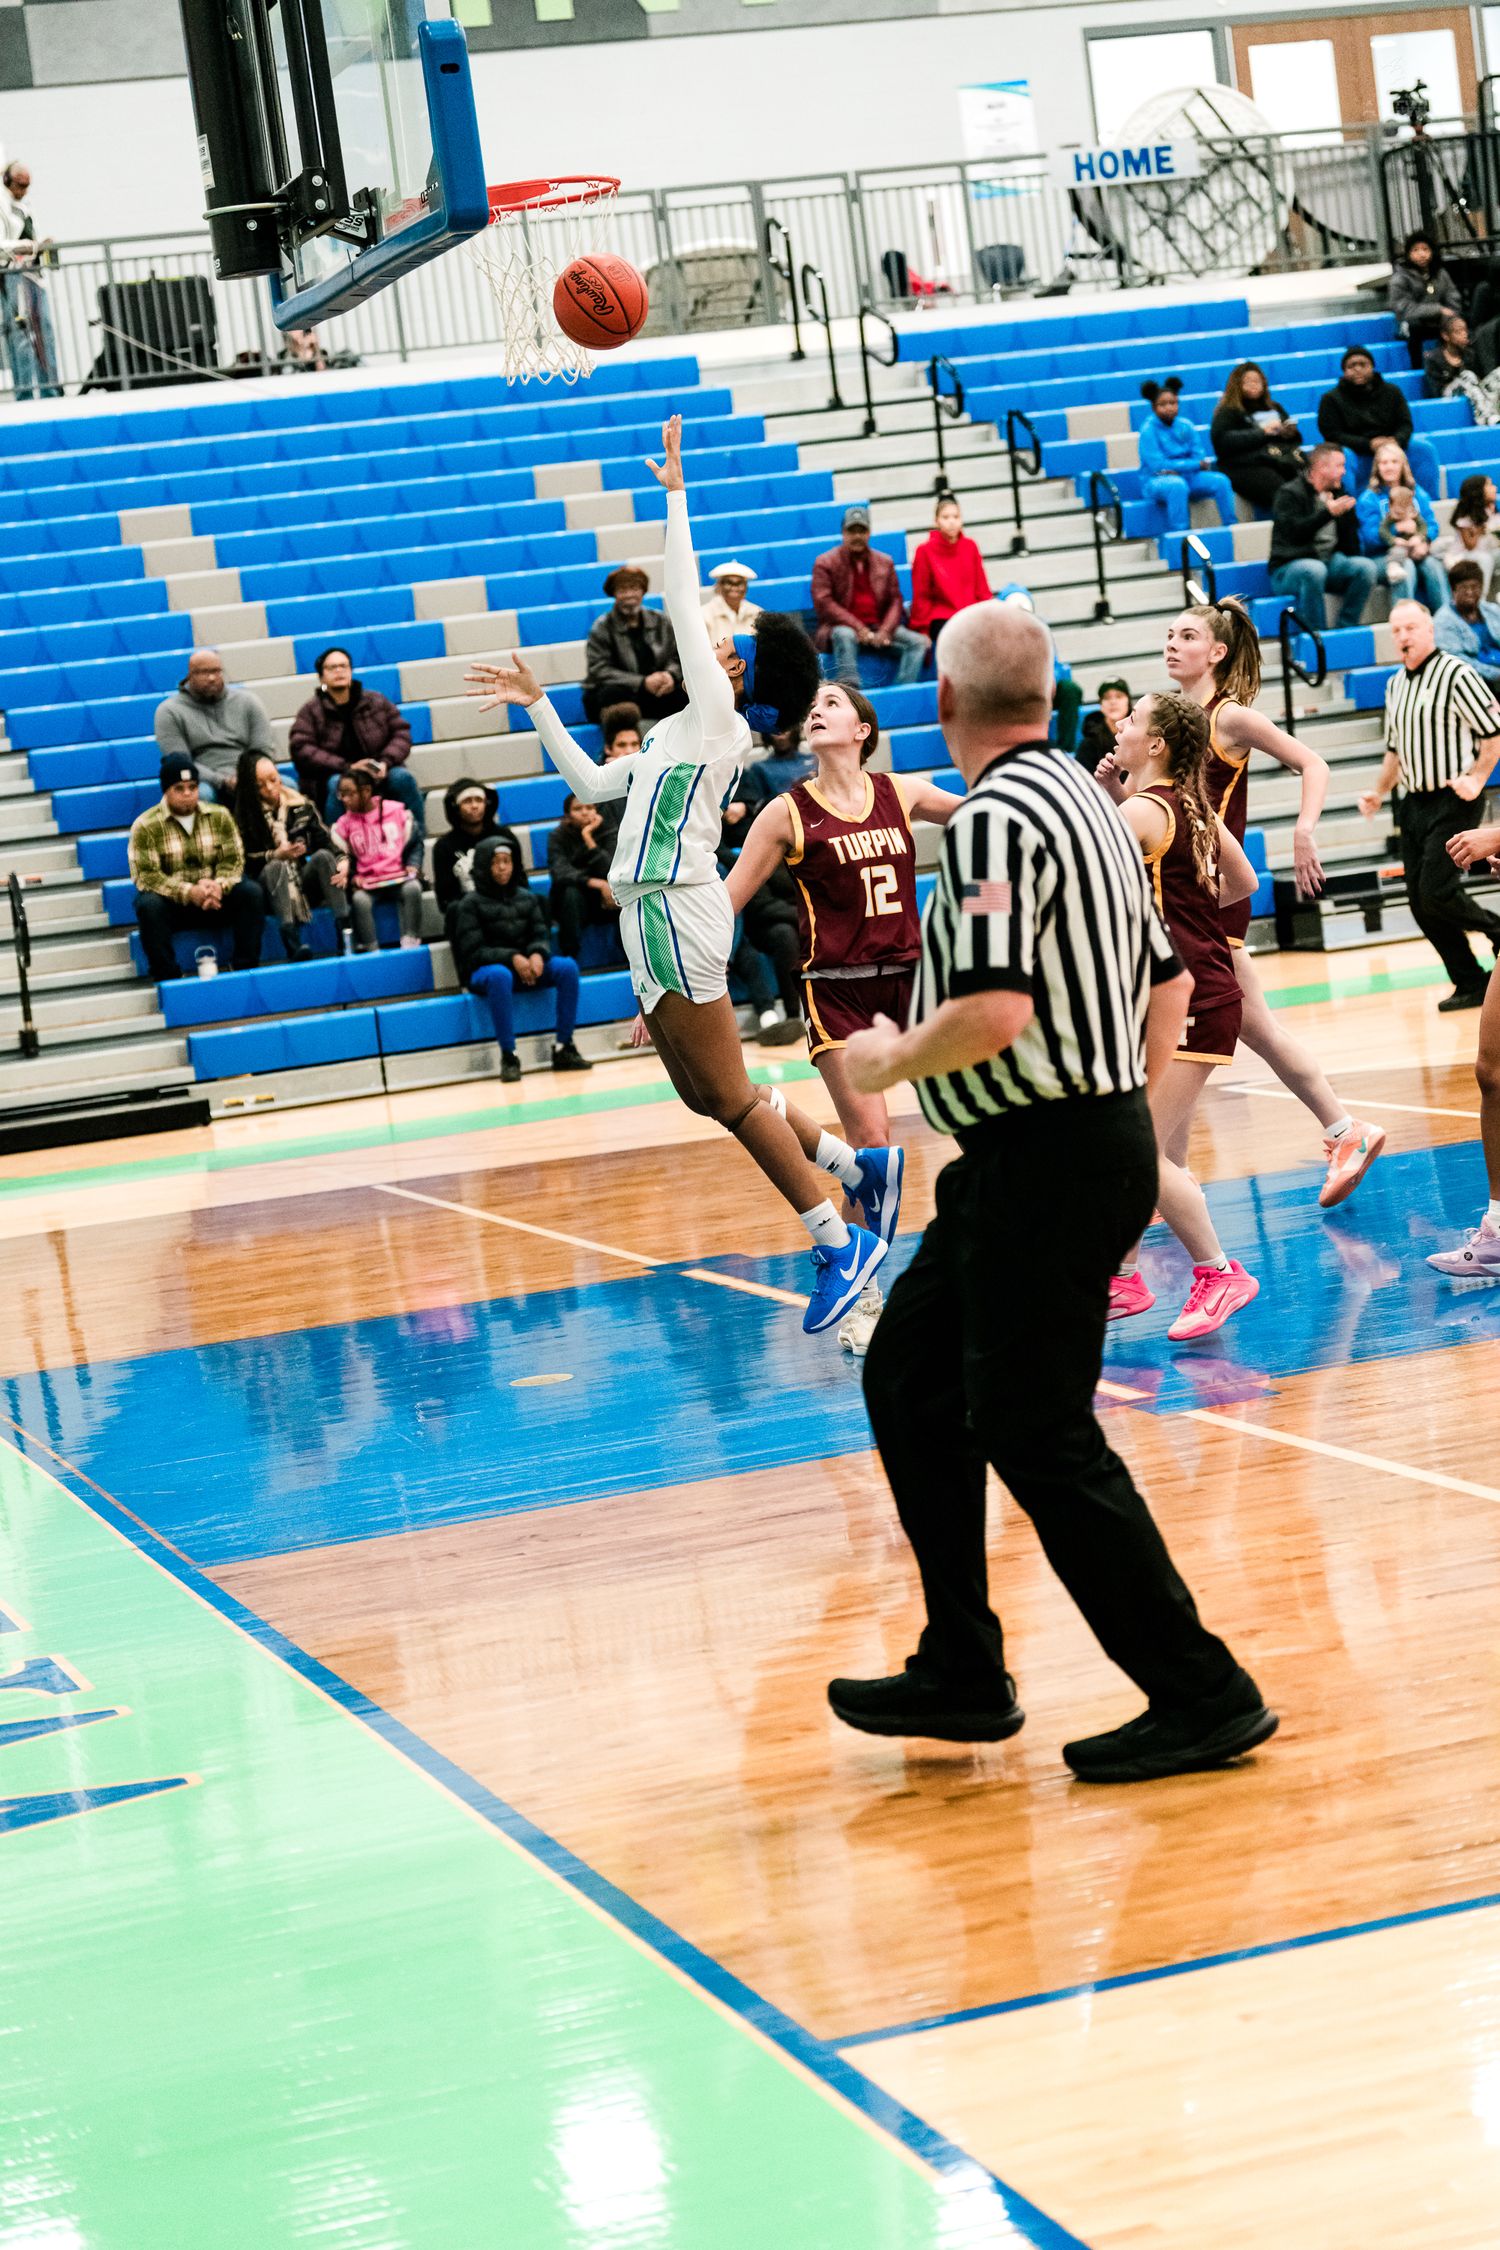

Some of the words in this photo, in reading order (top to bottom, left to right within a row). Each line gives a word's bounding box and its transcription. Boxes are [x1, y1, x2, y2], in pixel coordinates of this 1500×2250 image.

[1074, 146, 1174, 181] HOME
[568, 270, 615, 316] Rawlings
[828, 827, 907, 865] TURPIN
[859, 864, 903, 918] 12
